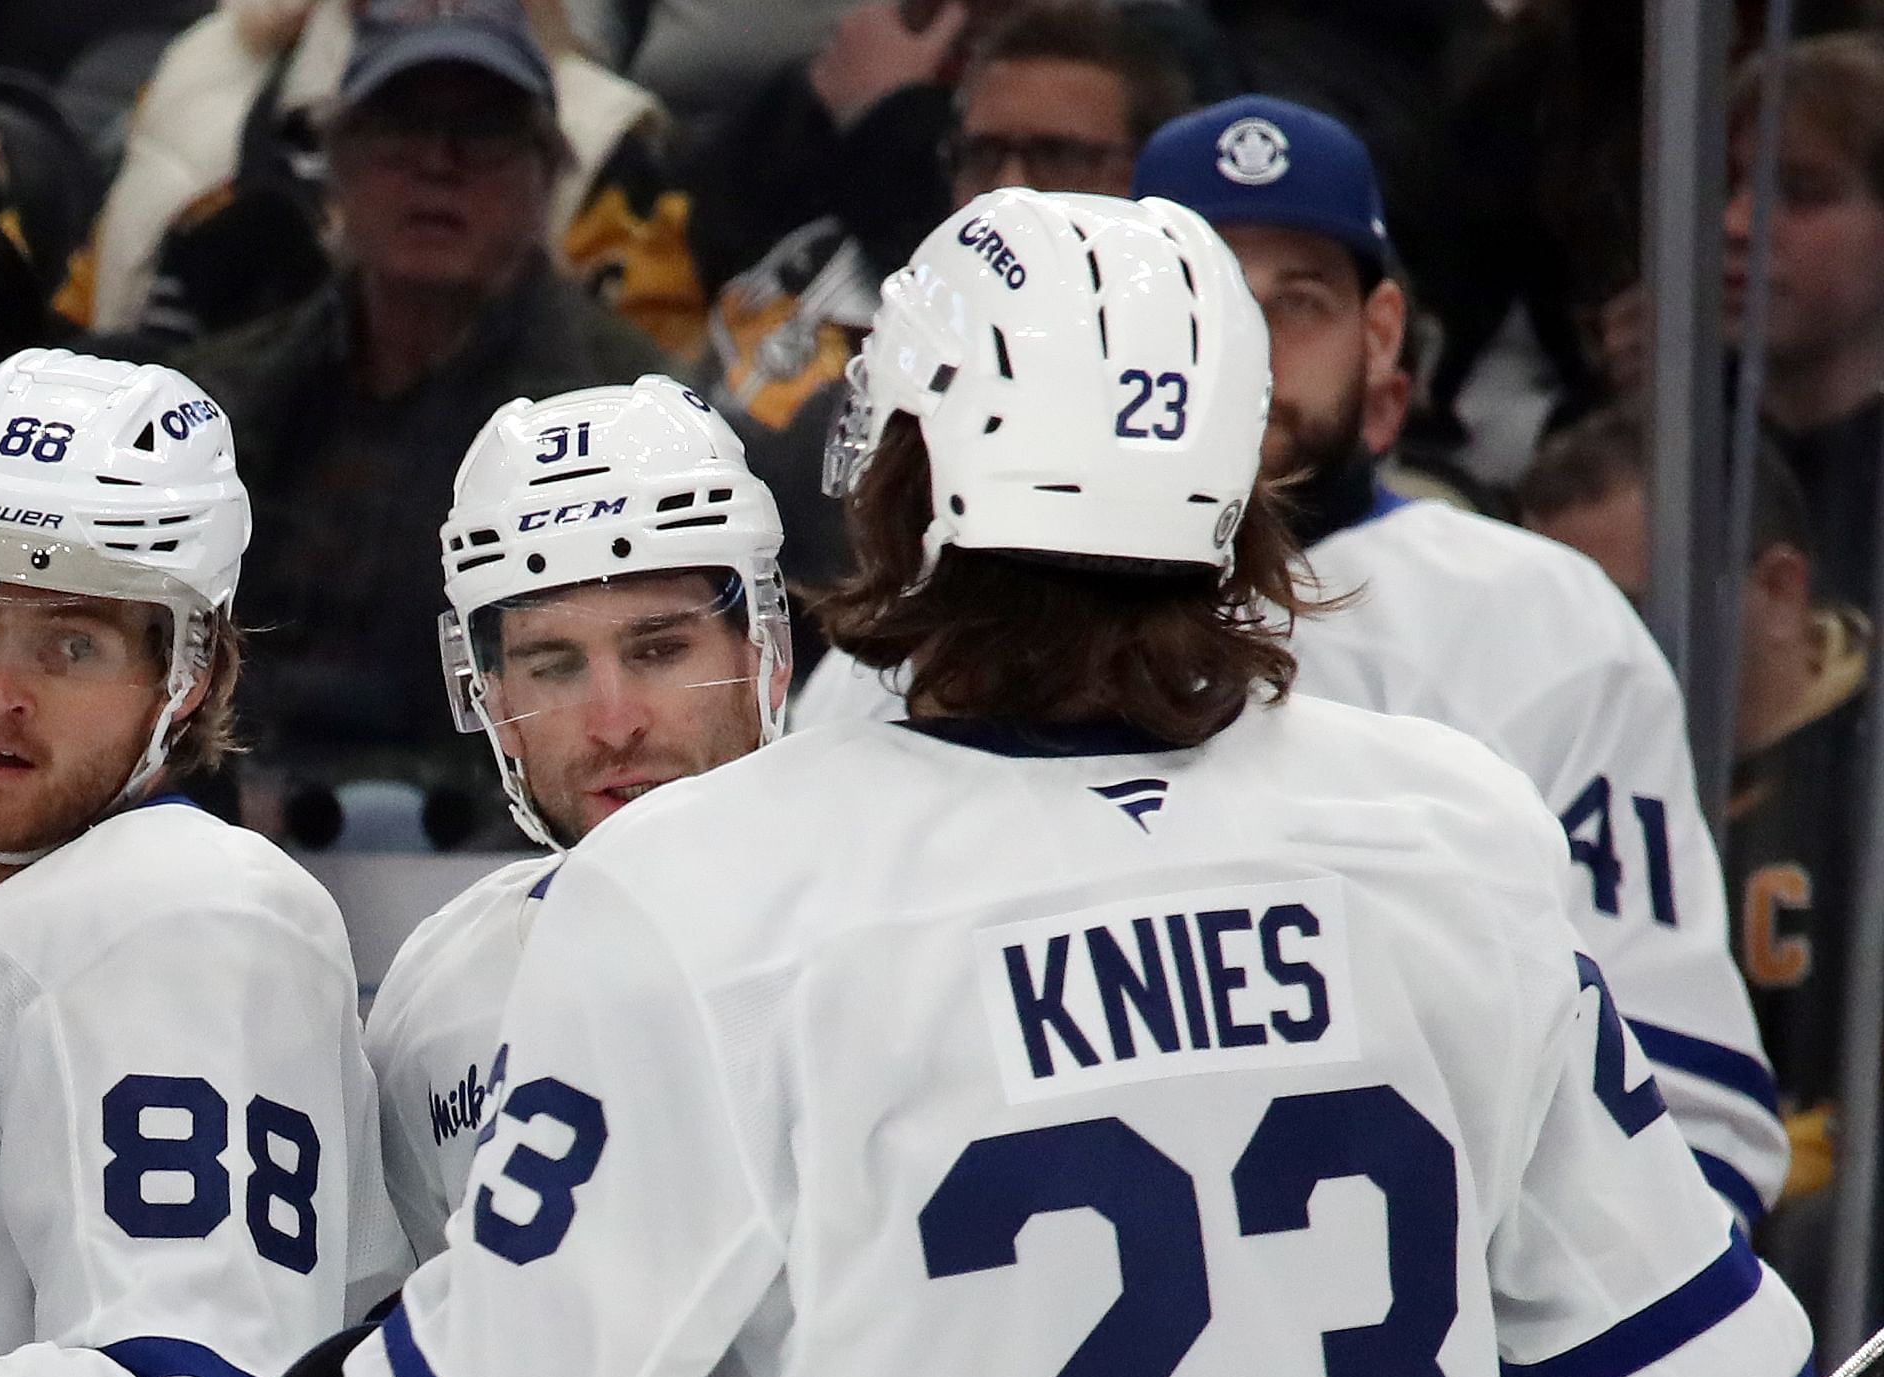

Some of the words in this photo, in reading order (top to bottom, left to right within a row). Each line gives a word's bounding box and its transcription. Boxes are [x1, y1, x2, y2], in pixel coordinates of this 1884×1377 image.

[958, 217, 1027, 292] OREO
[160, 400, 221, 440] OREO
[1115, 369, 1189, 441] 23
[518, 496, 629, 533] CCM
[1561, 774, 1679, 928] 41
[1744, 863, 1813, 985] C
[1002, 903, 1330, 1079] KNIES
[1574, 950, 1668, 1140] 2
[429, 1064, 486, 1147] Milk
[102, 1073, 320, 1276] 88
